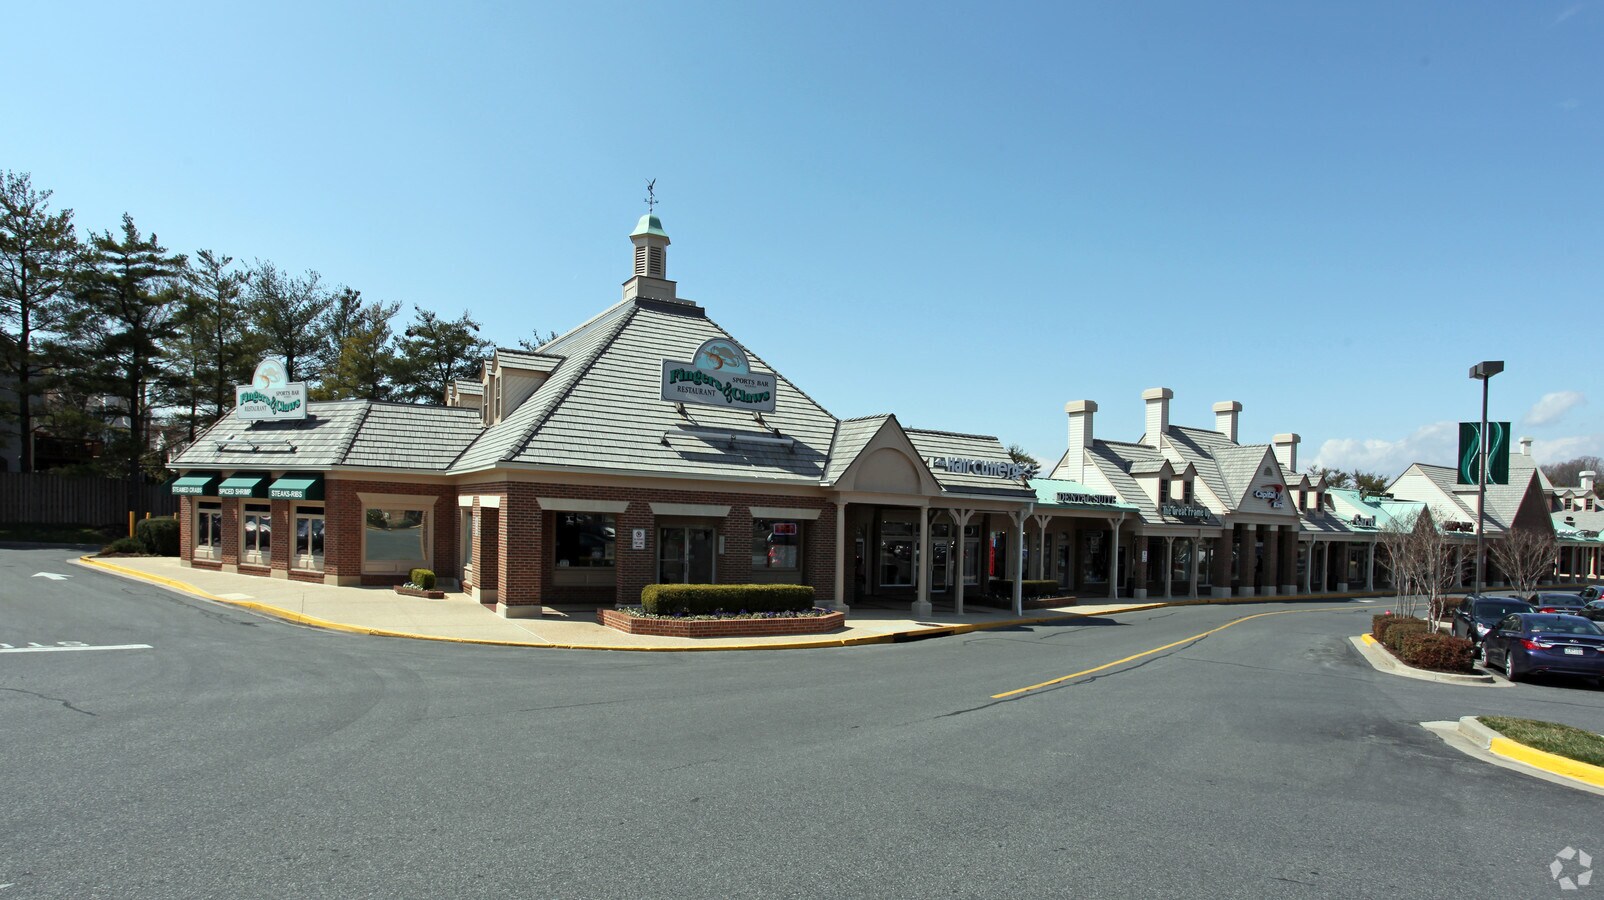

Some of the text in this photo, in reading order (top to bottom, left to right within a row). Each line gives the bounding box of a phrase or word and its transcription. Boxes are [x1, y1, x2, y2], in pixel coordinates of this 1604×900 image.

[669, 368, 770, 404] Fingers & Claws
[732, 377, 755, 385] SPORTS
[677, 385, 716, 397] RESTAURANT
[240, 391, 271, 406] Fingers
[275, 399, 301, 412] Claws
[947, 457, 1020, 480] Hair Cuttery
[235, 488, 252, 496] SHRIMP
[271, 490, 303, 498] STEAKS-RIBS
[1057, 492, 1117, 504] DENTAL SUITE
[1254, 490, 1275, 499] Capital
